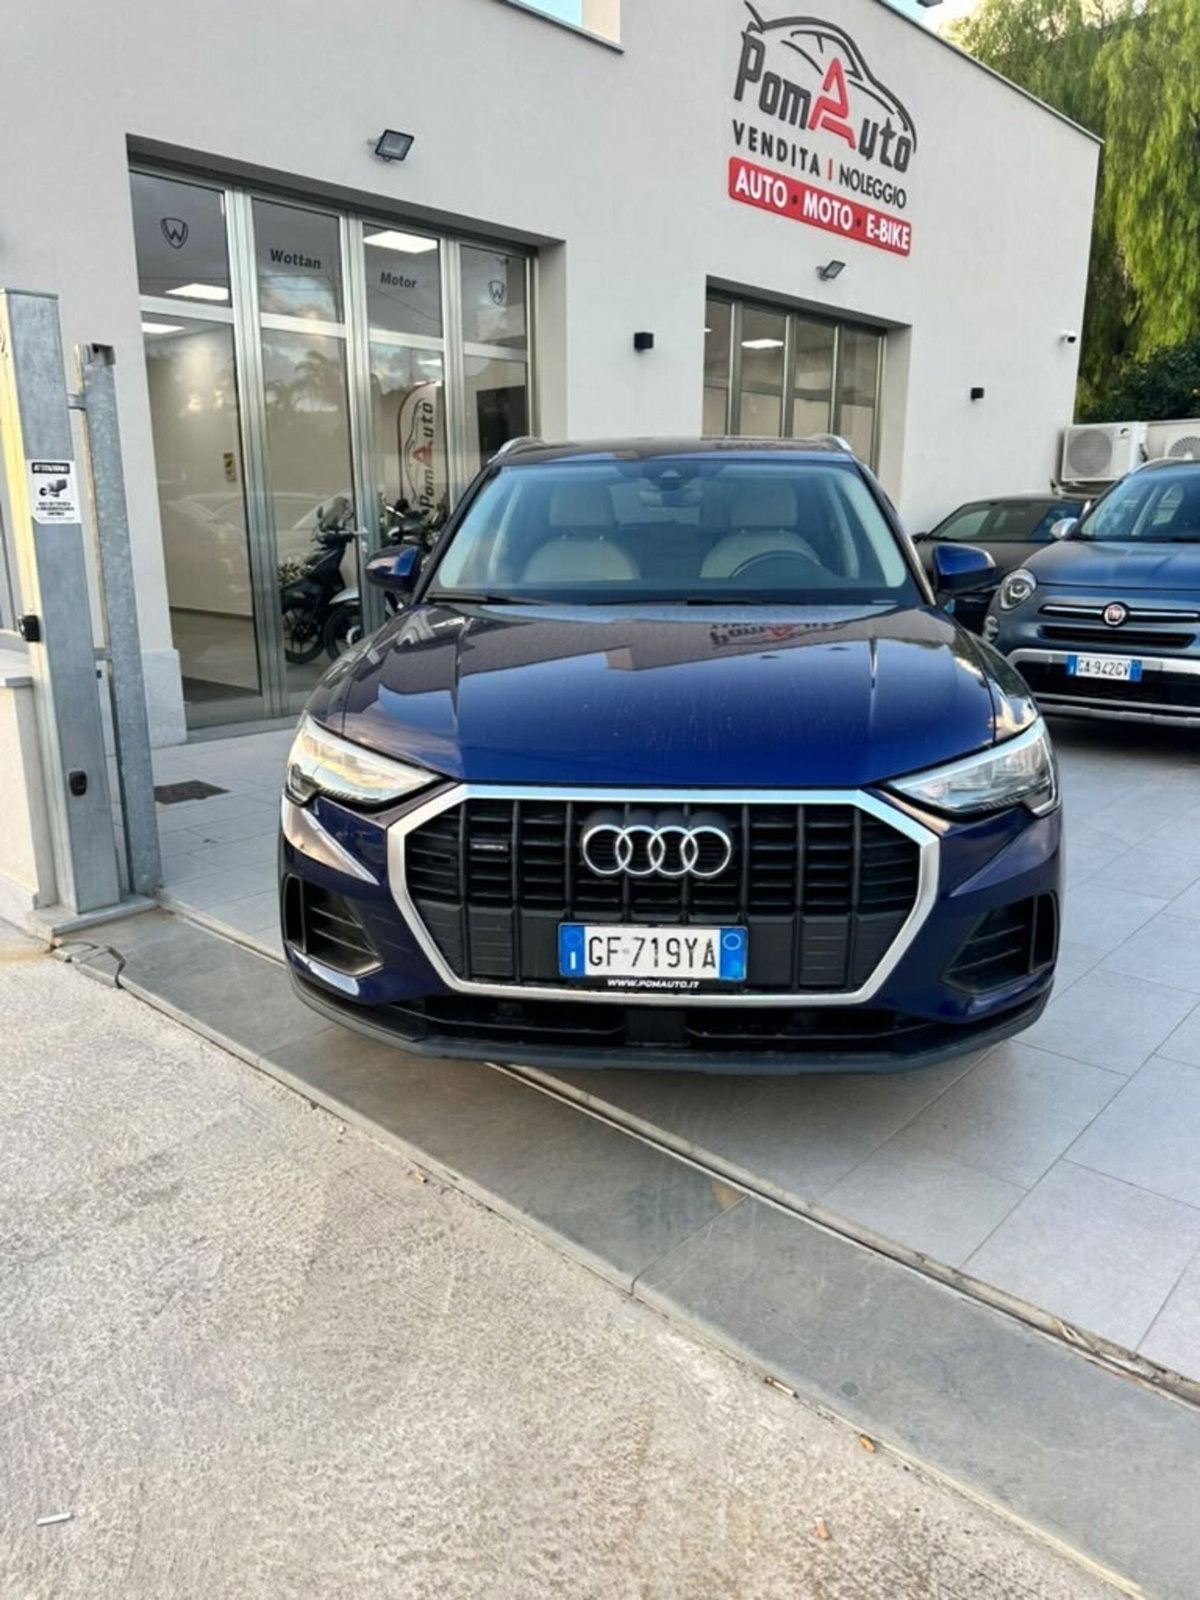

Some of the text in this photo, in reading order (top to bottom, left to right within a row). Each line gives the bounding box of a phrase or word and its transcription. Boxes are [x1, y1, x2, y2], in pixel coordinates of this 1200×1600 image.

[734, 31, 912, 174] PomAuto
[732, 118, 907, 209] VENDITA NOLEGGIO
[735, 166, 909, 250] AUTO MOTO E-BIKE
[270, 248, 322, 270] Wottan
[380, 271, 417, 288] Motor
